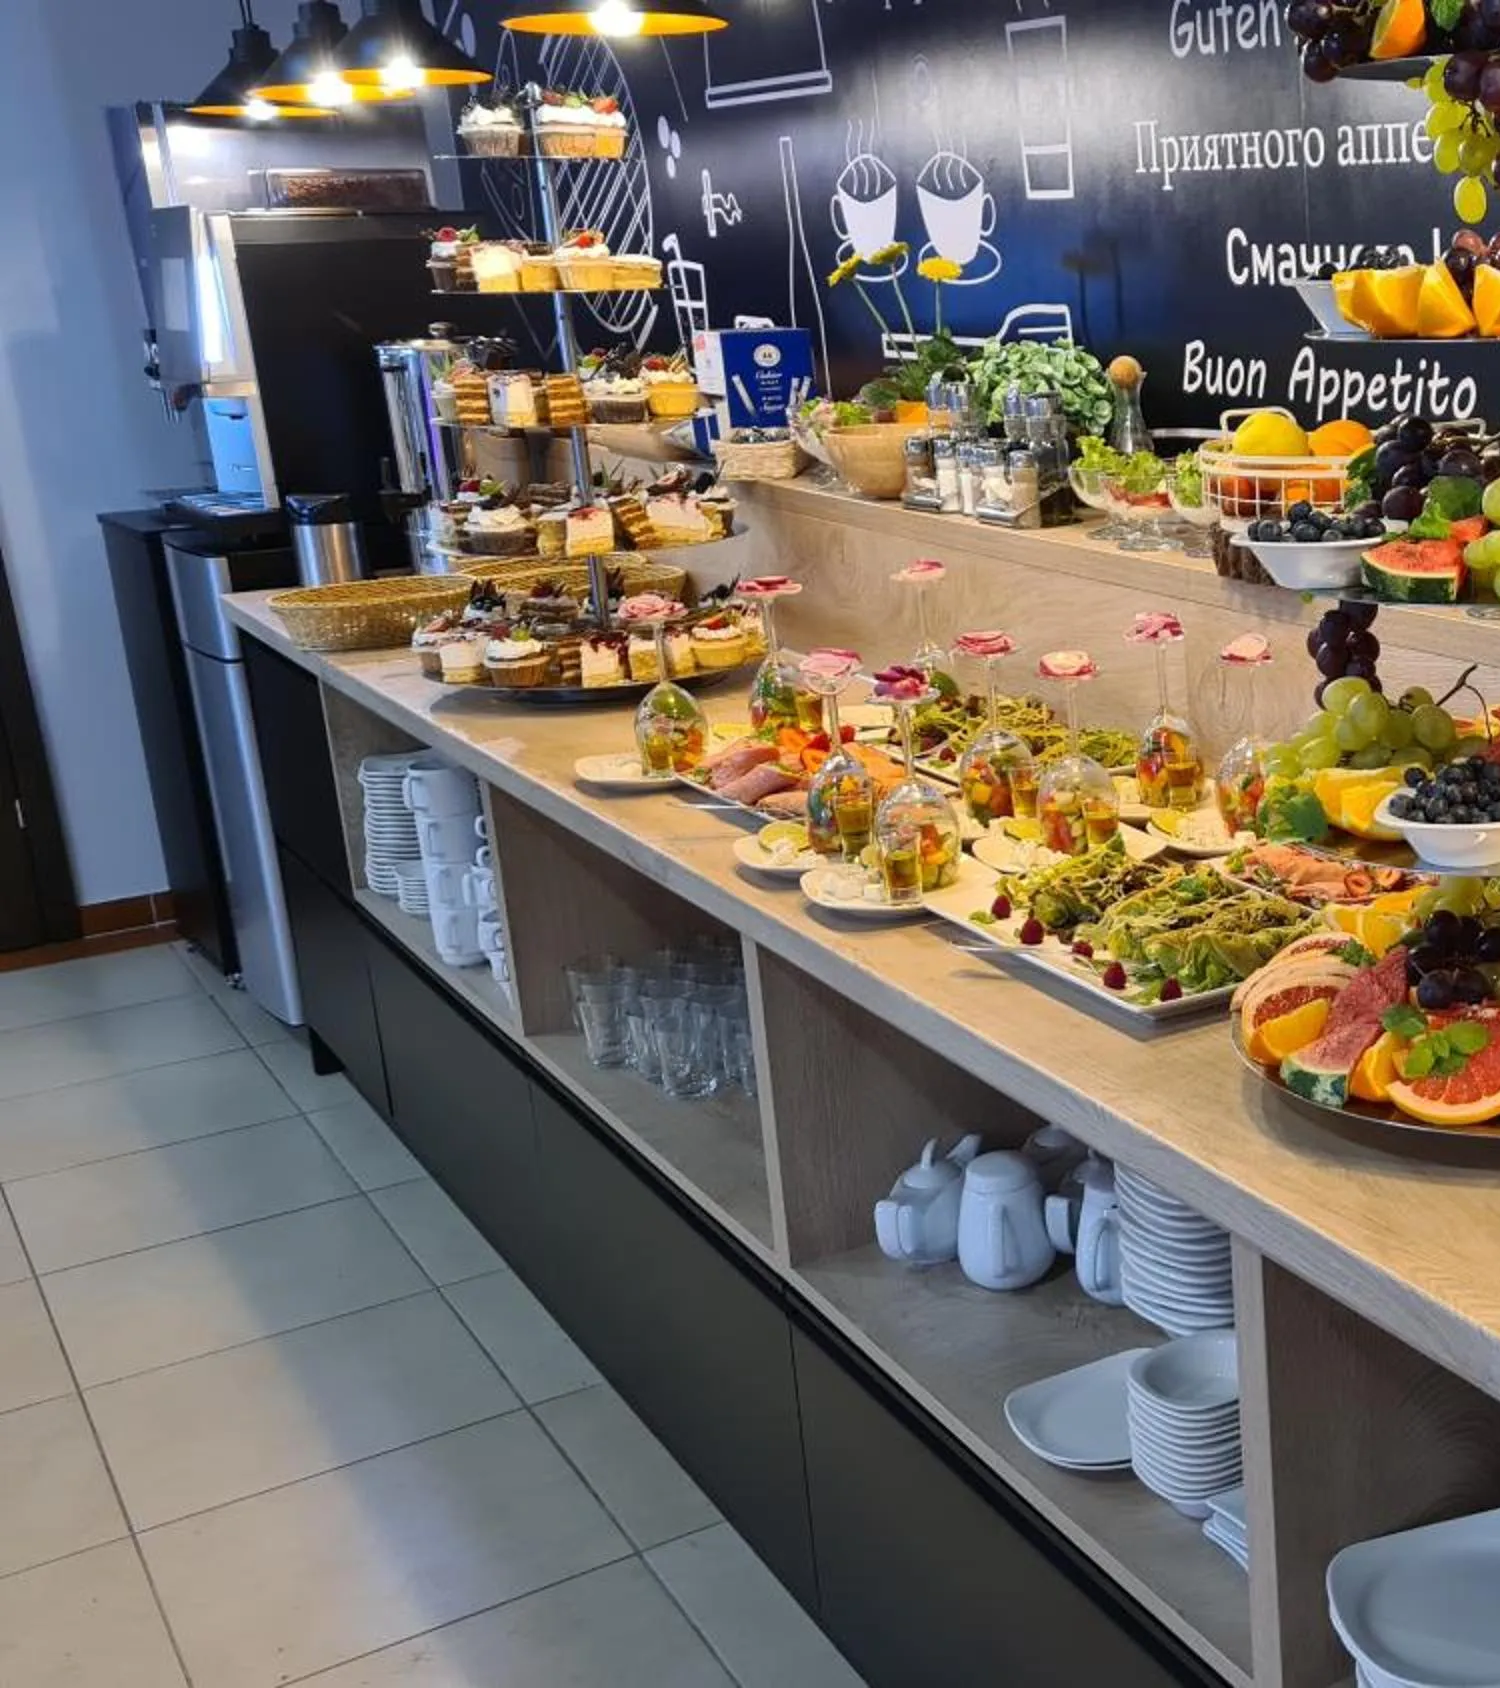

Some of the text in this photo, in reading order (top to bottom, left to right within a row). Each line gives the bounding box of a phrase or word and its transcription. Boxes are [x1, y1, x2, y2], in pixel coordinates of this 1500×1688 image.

[1169, 0, 1281, 58] Guten
[1134, 119, 1432, 190] Приятного аппе
[1183, 340, 1268, 399] Buon
[1288, 346, 1478, 422] Appetito
